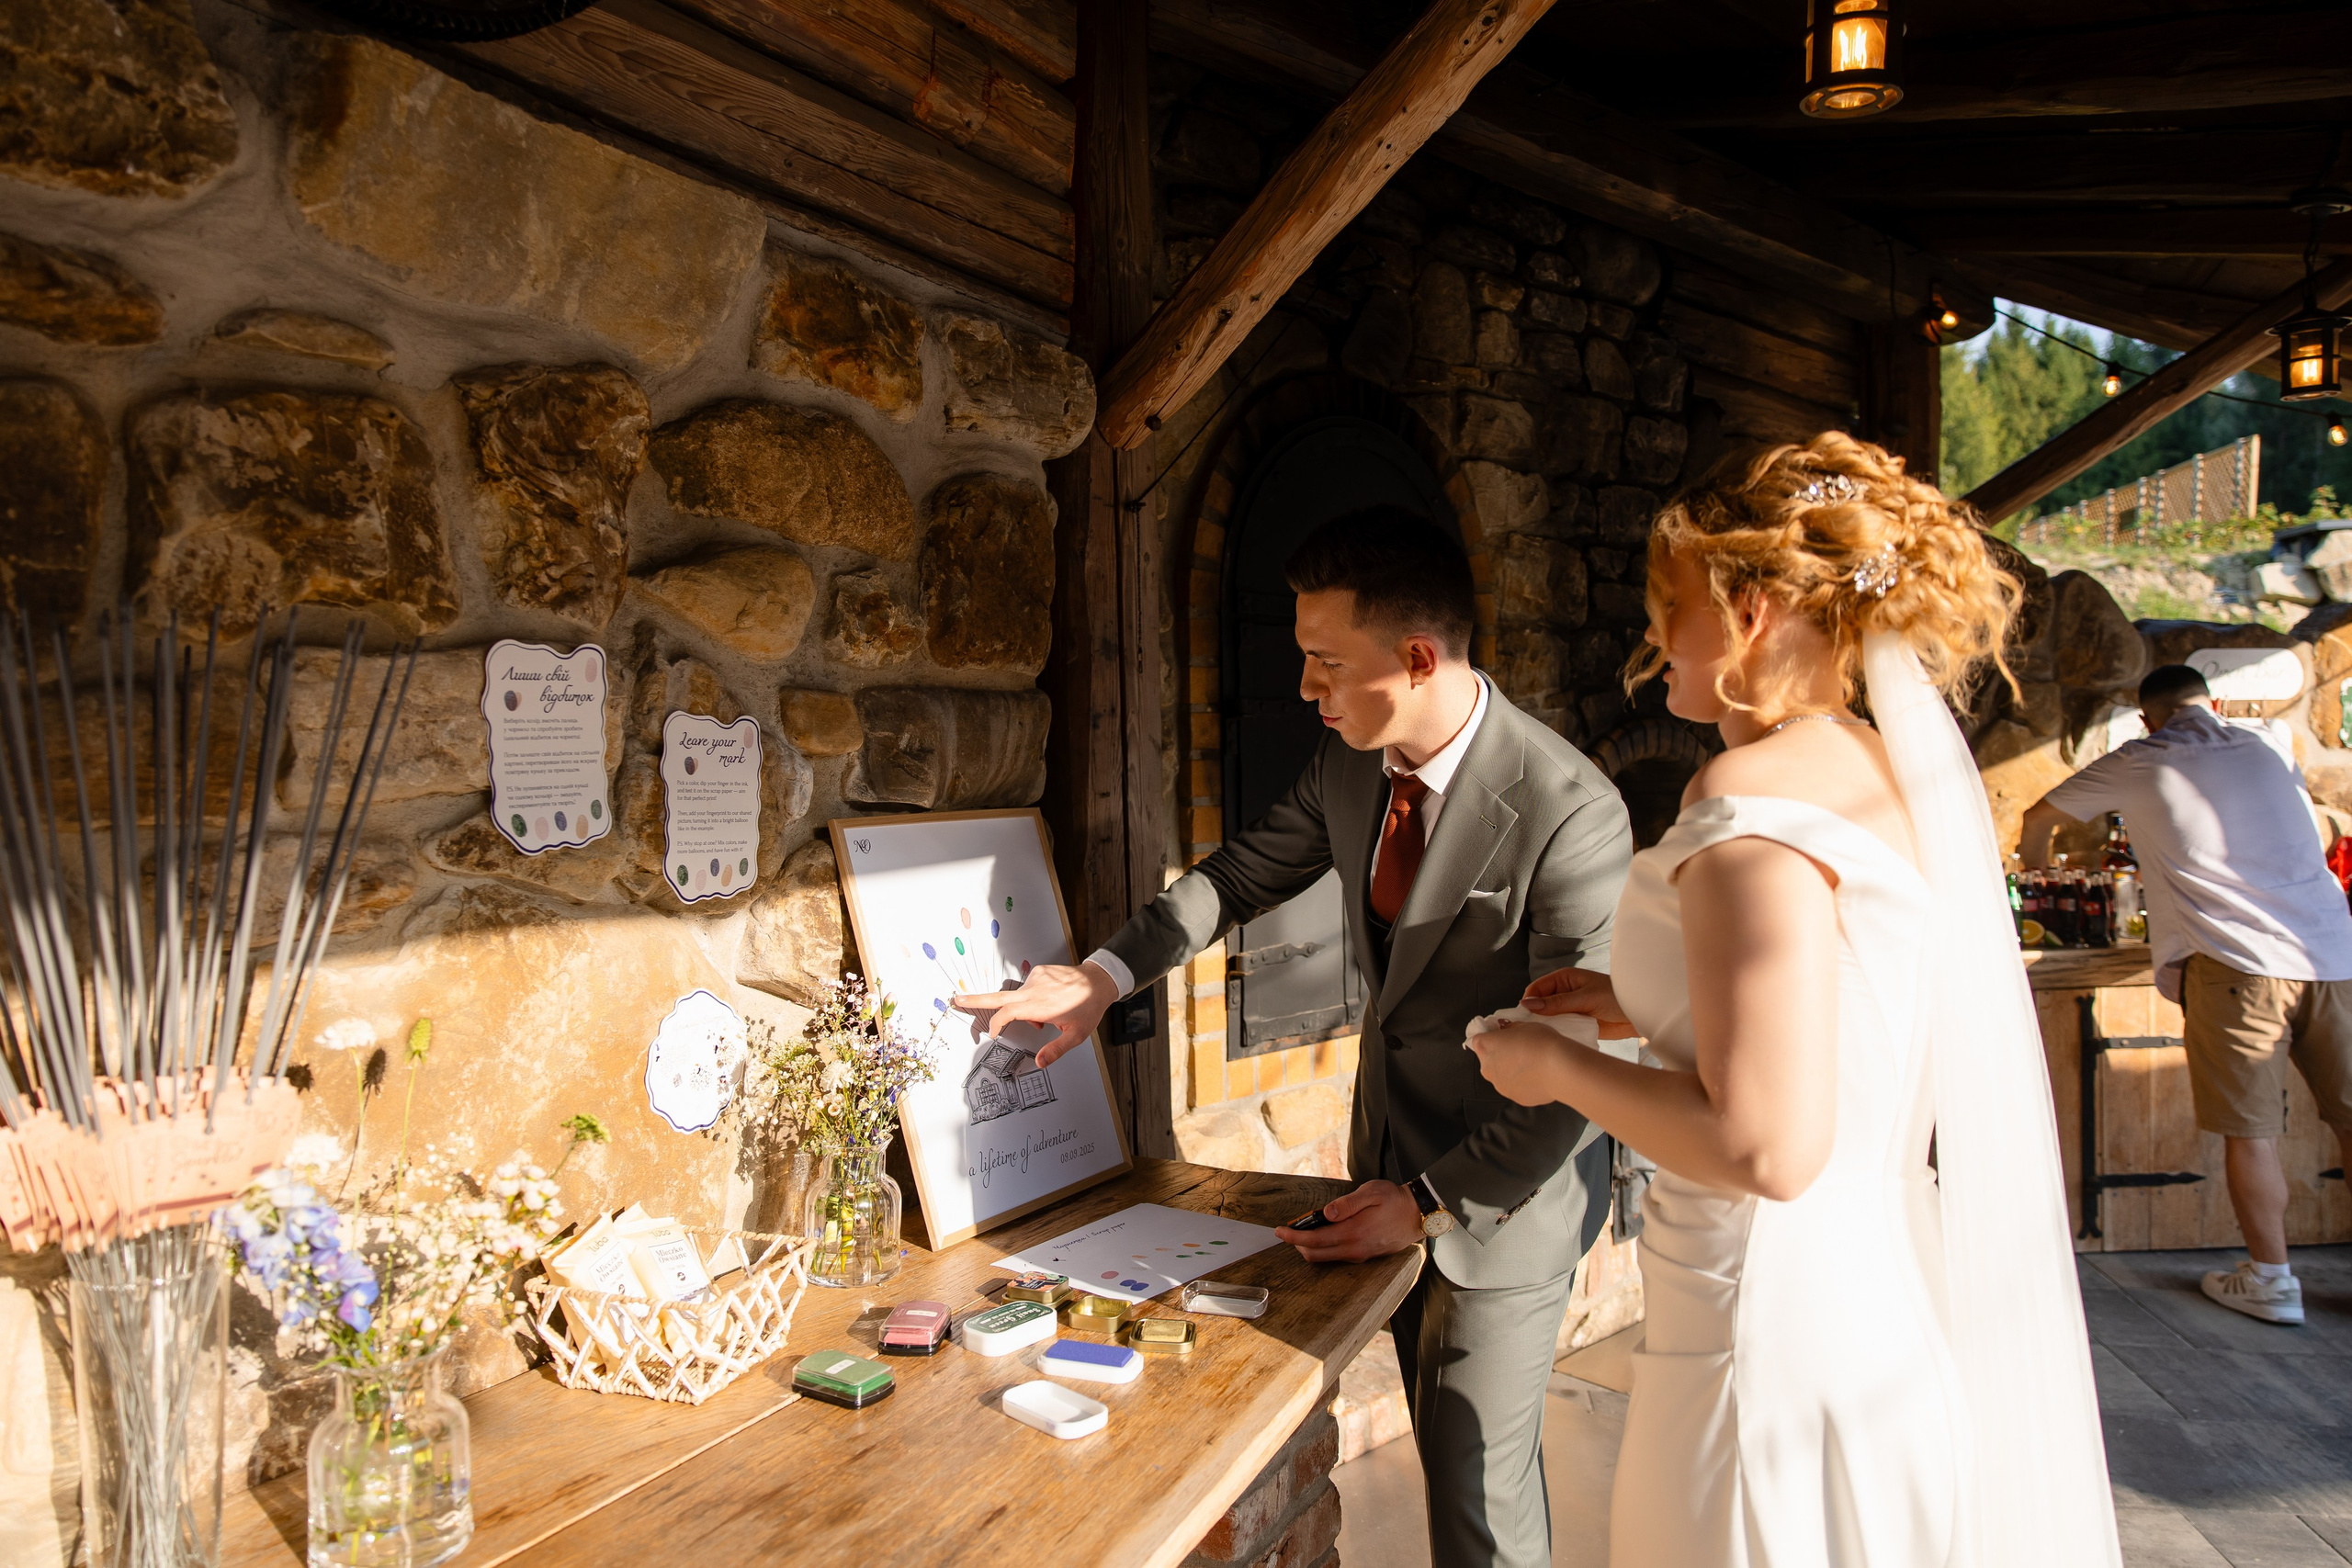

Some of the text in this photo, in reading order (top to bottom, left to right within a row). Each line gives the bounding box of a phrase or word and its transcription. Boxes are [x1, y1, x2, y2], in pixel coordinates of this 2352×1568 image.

[501, 665, 571, 681] Лиши свій
[539, 684, 594, 713] відбиток
[679, 732, 736, 755] Leave your
[718, 748, 746, 767] mark
[968, 1129, 1079, 1189] a lifetime of adventure
[1111, 1223, 1125, 1232] paper
[656, 1247, 684, 1257] Mleczko
